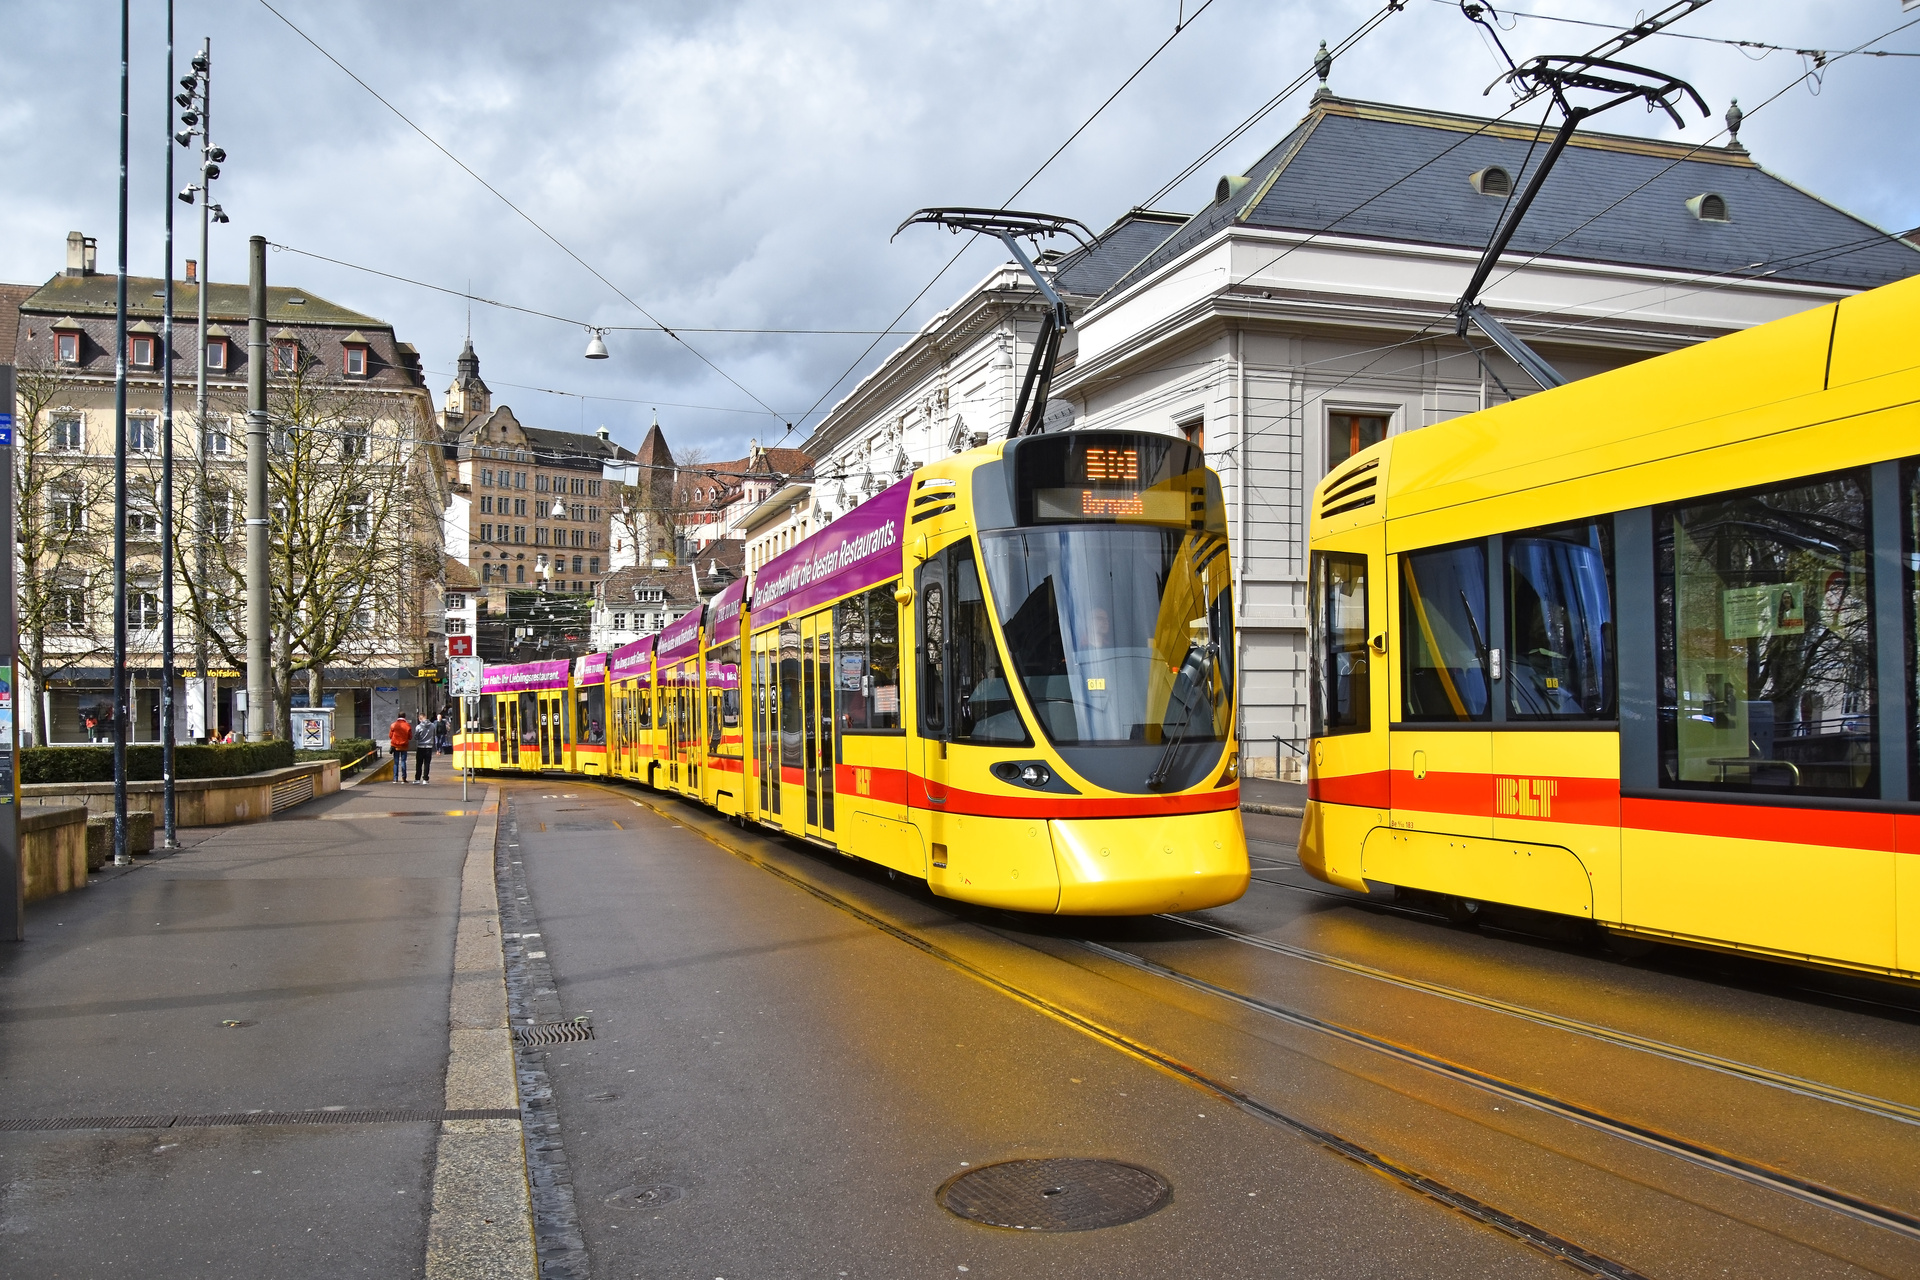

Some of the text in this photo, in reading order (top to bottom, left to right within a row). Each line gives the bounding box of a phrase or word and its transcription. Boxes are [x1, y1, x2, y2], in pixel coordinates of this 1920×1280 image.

[753, 519, 896, 609] Der Gutschein für die besten Restaurants.
[182, 670, 197, 678] Jac
[856, 768, 871, 796] BLT
[1496, 778, 1557, 817] BLT
